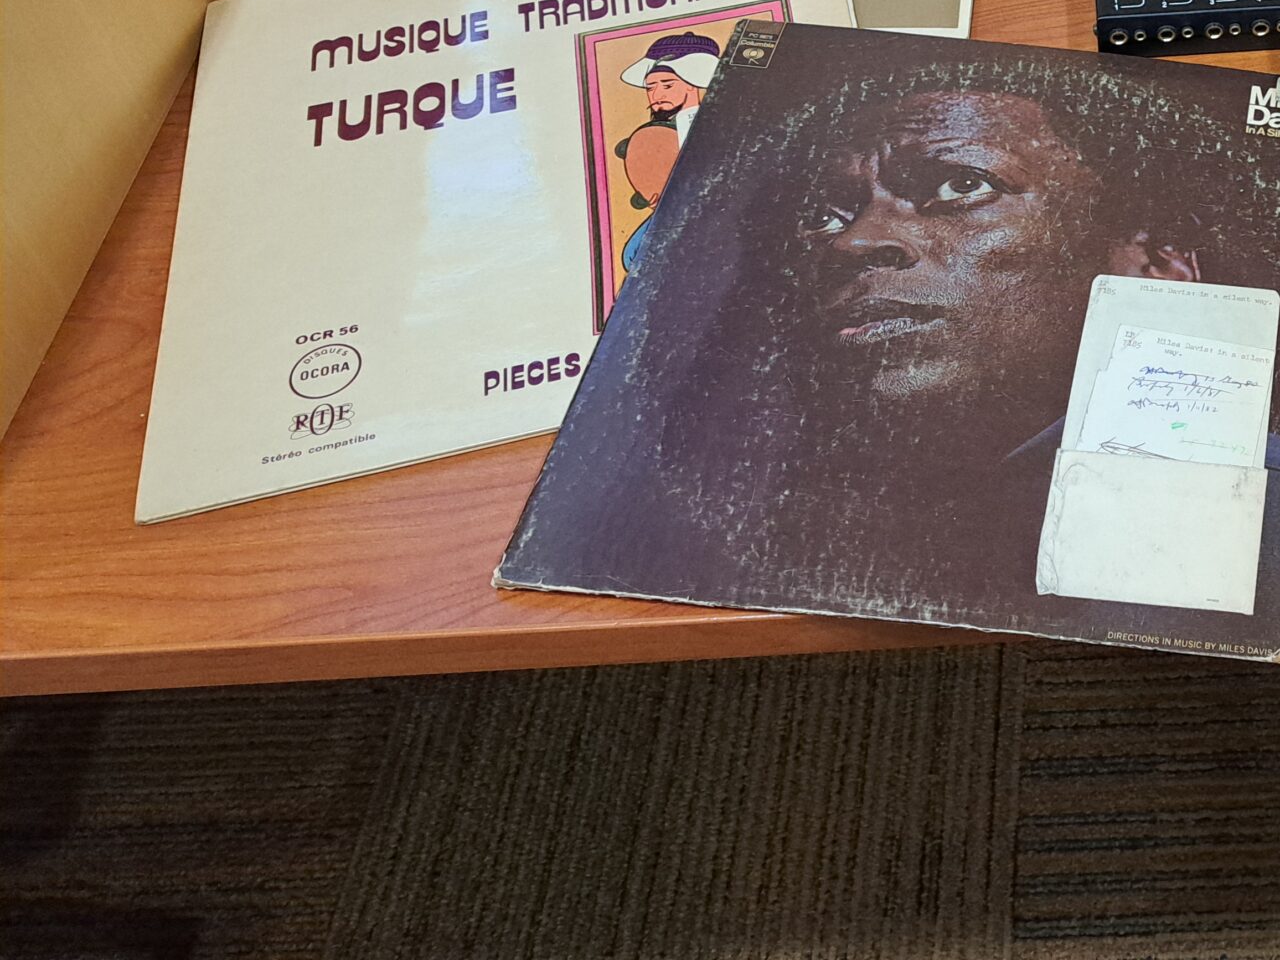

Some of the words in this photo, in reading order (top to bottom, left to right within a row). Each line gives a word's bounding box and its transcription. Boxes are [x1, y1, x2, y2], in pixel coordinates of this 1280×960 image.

[310, 10, 490, 71] MUSIQUE
[740, 39, 775, 49] Columbia
[306, 68, 518, 147] TURQUE
[1245, 125, 1256, 135] In
[1256, 127, 1266, 136] A
[1139, 284, 1164, 294] Miles
[1222, 294, 1251, 303] silent
[295, 329, 334, 345] OCR
[339, 324, 359, 336] 56
[303, 347, 349, 365] DISQUES
[1156, 337, 1181, 348] Miles
[1241, 353, 1270, 364] silent
[300, 361, 350, 381] OCORA
[483, 352, 581, 396] PIECES
[261, 449, 303, 465] Stéréo
[307, 433, 377, 455] compatible
[1107, 631, 1160, 645] DIRECTIONS
[1162, 637, 1172, 646] IN
[1173, 638, 1203, 650] MUSIC
[1204, 642, 1217, 651] BY
[1218, 644, 1246, 654] MILES
[1247, 646, 1273, 657] DAVIS
